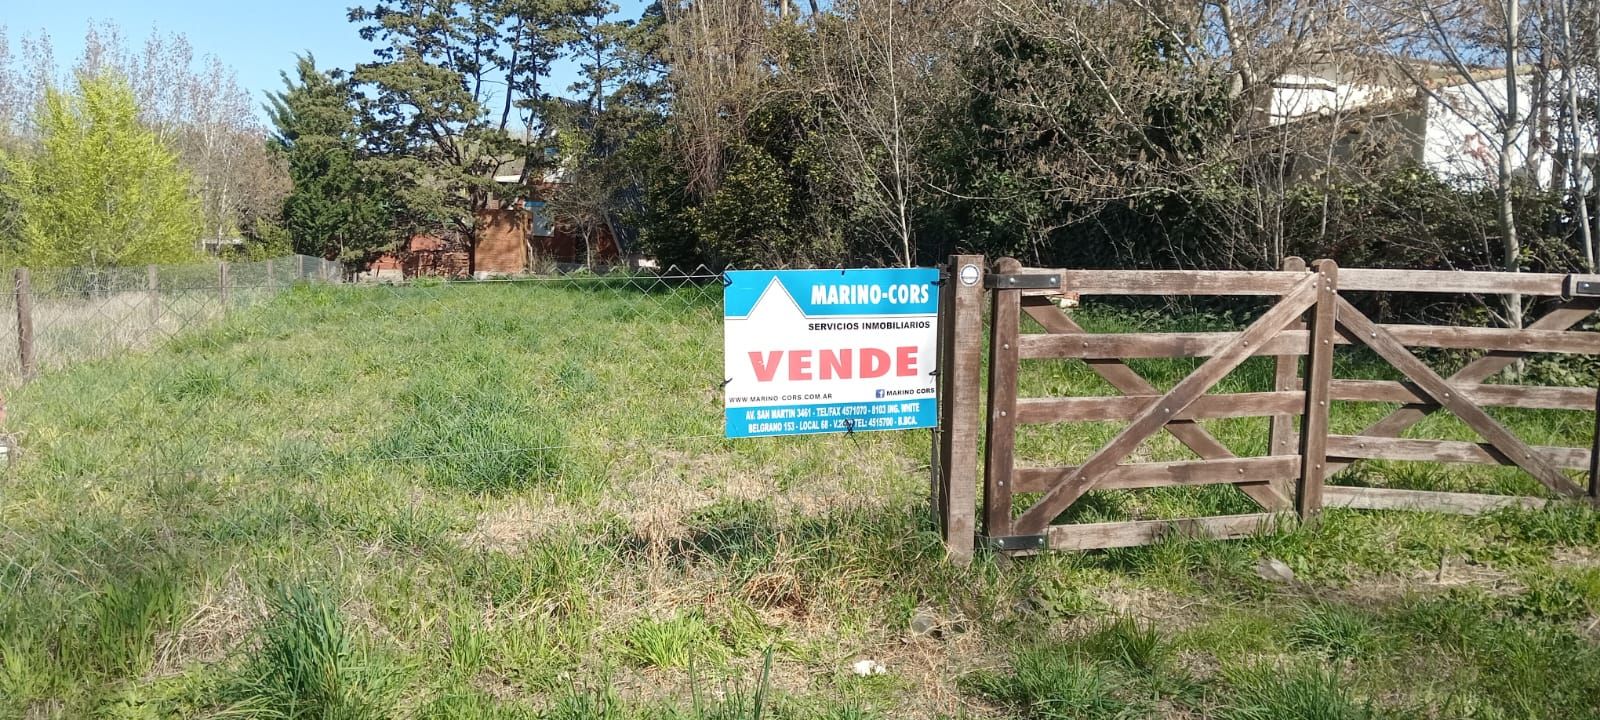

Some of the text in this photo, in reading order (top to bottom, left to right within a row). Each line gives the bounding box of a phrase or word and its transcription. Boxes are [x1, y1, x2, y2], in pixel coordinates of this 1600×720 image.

[811, 284, 929, 304] MARINO-CORS
[808, 321, 930, 330] SERVICIOS INMOBILIARIOS
[748, 346, 918, 382] VENDE
[746, 410, 756, 420] AV.
[756, 410, 770, 419] SAN
[772, 408, 796, 419] MARTIN
[796, 408, 811, 418] 3461
[816, 406, 840, 417] TEL/FAX
[842, 406, 867, 416] 4571070
[872, 404, 886, 414] 8103
[887, 404, 900, 413] ING.
[901, 402, 920, 412] WHITE
[748, 422, 782, 433] BELGRANO
[784, 422, 795, 431] 153
[800, 420, 819, 430] LOCAL
[868, 417, 893, 426] 4515700
